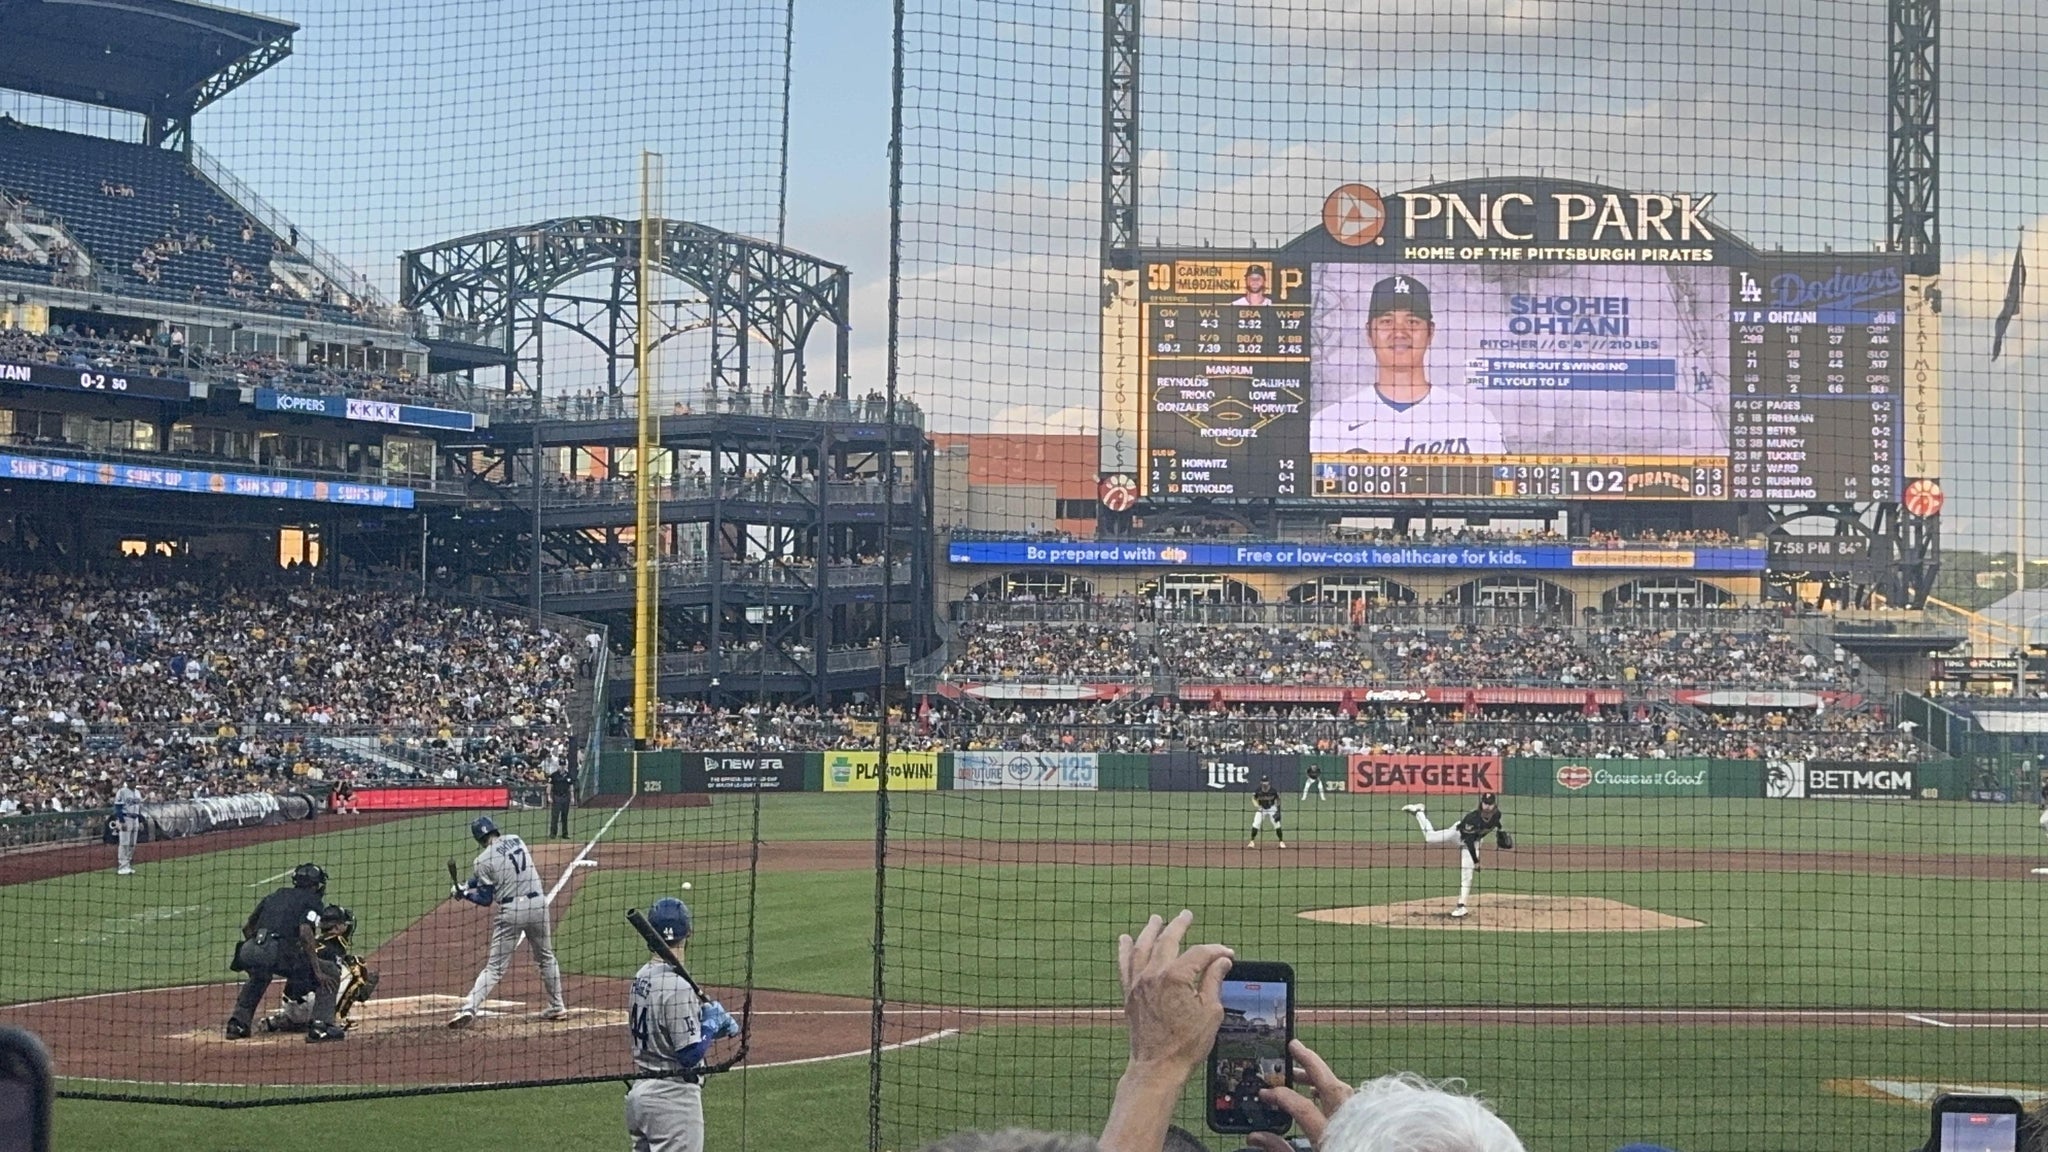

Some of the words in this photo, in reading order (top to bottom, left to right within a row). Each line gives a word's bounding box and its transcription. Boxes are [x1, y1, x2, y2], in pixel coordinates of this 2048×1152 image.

[1398, 192, 1534, 241] PNC
[1551, 192, 1717, 242] PARK
[1405, 247, 1455, 261] HOME
[1459, 247, 1485, 261] OF
[1488, 247, 1522, 261] THE
[1527, 247, 1636, 262] PITTSBURGH
[1641, 248, 1714, 262] PIRATES
[1148, 264, 1171, 291] 50
[1178, 266, 1222, 277] CARMEN
[1280, 268, 1303, 300] P
[1770, 266, 1902, 308] Dodgers
[1510, 296, 1629, 315] SHOHEI
[1239, 310, 1261, 318] ERA
[1733, 311, 1746, 323] 17
[1768, 311, 1817, 323] OHTANI
[1508, 317, 1630, 336] OHTANI
[1480, 339, 1538, 350] PITCHER
[1609, 340, 1632, 350] 210
[1635, 340, 1659, 350] LBS
[1205, 365, 1253, 375] MANGUM
[1493, 361, 1561, 371] STRIKEOUT
[1562, 362, 1629, 371] SWINGING
[80, 373, 105, 389] 0-2
[1157, 377, 1209, 387] REYNOLDS
[1493, 378, 1538, 386] FLYOUT
[1540, 378, 1555, 386] TO
[1249, 391, 1277, 400] LOWE
[276, 394, 326, 412] KOPPERS
[1156, 402, 1209, 412] GONZALES
[1252, 404, 1299, 413] HORWITZ
[1767, 401, 1801, 410] PAGES
[1767, 439, 1805, 448] MUNCY
[1767, 451, 1806, 461] TUCKER
[1181, 459, 1228, 469] HORWITZ
[1767, 464, 1799, 473] WARD
[10, 460, 49, 477] SUN'S
[52, 464, 69, 478] UP
[126, 469, 163, 484] SUN'S
[165, 472, 182, 486] UP
[236, 478, 269, 494] SUN'S
[272, 480, 288, 494] UP
[1181, 471, 1210, 481] LOWE
[1518, 467, 1527, 478] 3
[1550, 467, 1560, 479] 2
[1695, 468, 1705, 479] 2
[1712, 468, 1722, 480] 3
[1627, 471, 1690, 493] PIRATES
[1767, 477, 1813, 486] RUSHING
[1181, 484, 1234, 494] REYNOLDS
[1518, 483, 1527, 494] 3
[1550, 483, 1560, 494] 5
[1712, 484, 1722, 495] 3
[1773, 541, 1804, 554] 7:58
[1808, 542, 1830, 554] PM
[1050, 547, 1119, 563] prepared
[1123, 547, 1156, 560] with
[1237, 549, 1273, 563] Free
[1276, 551, 1293, 563] or
[1297, 549, 1369, 564] low-cost
[1372, 549, 1458, 565] healthcare
[1462, 550, 1485, 565] for
[1489, 550, 1527, 565] kids.
[856, 763, 888, 780] PLA
[903, 763, 933, 779] WIN!
[971, 768, 1003, 780] FUTURE
[1060, 756, 1092, 782] 125
[1356, 760, 1492, 790] SEATGEEK
[1207, 762, 1249, 789] Lite
[1594, 769, 1653, 785] Growers
[1664, 769, 1706, 785] Good
[1809, 770, 1912, 790] BETMGM
[508, 848, 527, 874] 17
